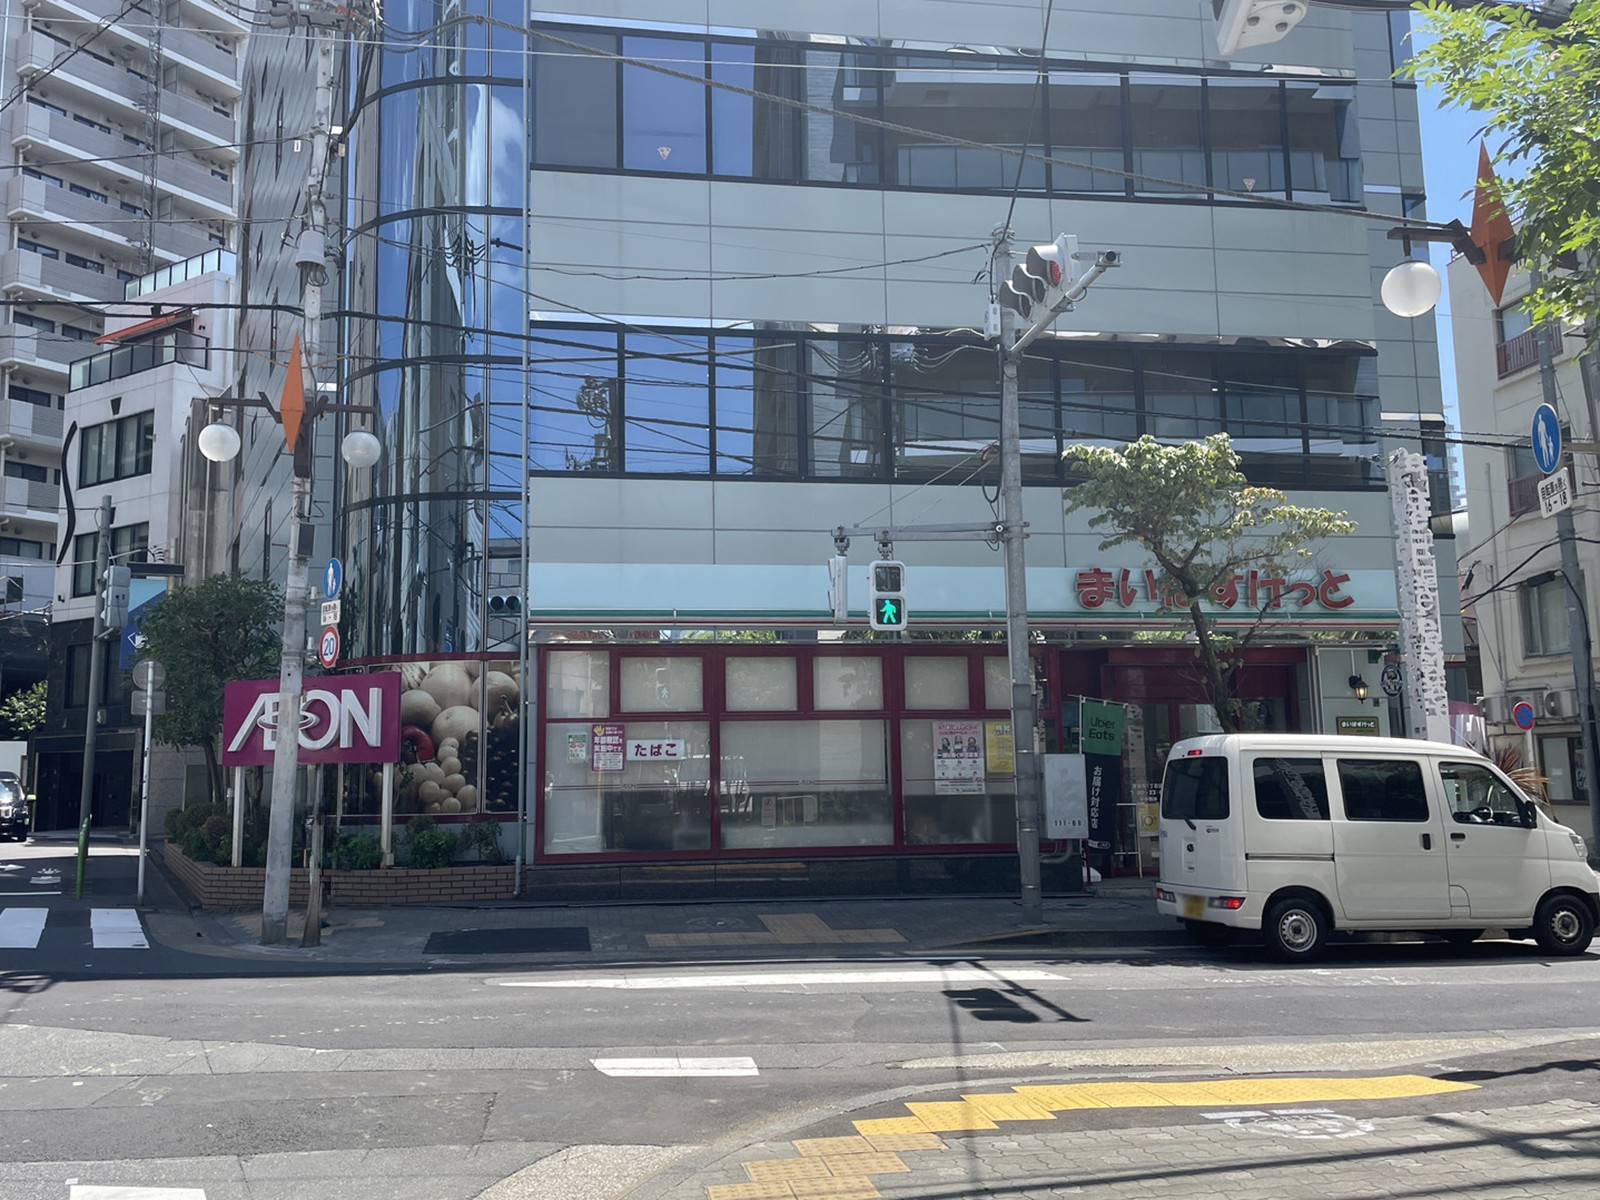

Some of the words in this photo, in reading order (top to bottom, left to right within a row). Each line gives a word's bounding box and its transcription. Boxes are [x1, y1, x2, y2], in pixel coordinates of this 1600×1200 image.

[323, 638, 335, 656] 20
[1090, 717, 1116, 729] Uber
[1089, 728, 1116, 741] Eats
[634, 743, 677, 757] たばこ
[1090, 766, 1103, 829] お届け対応店
